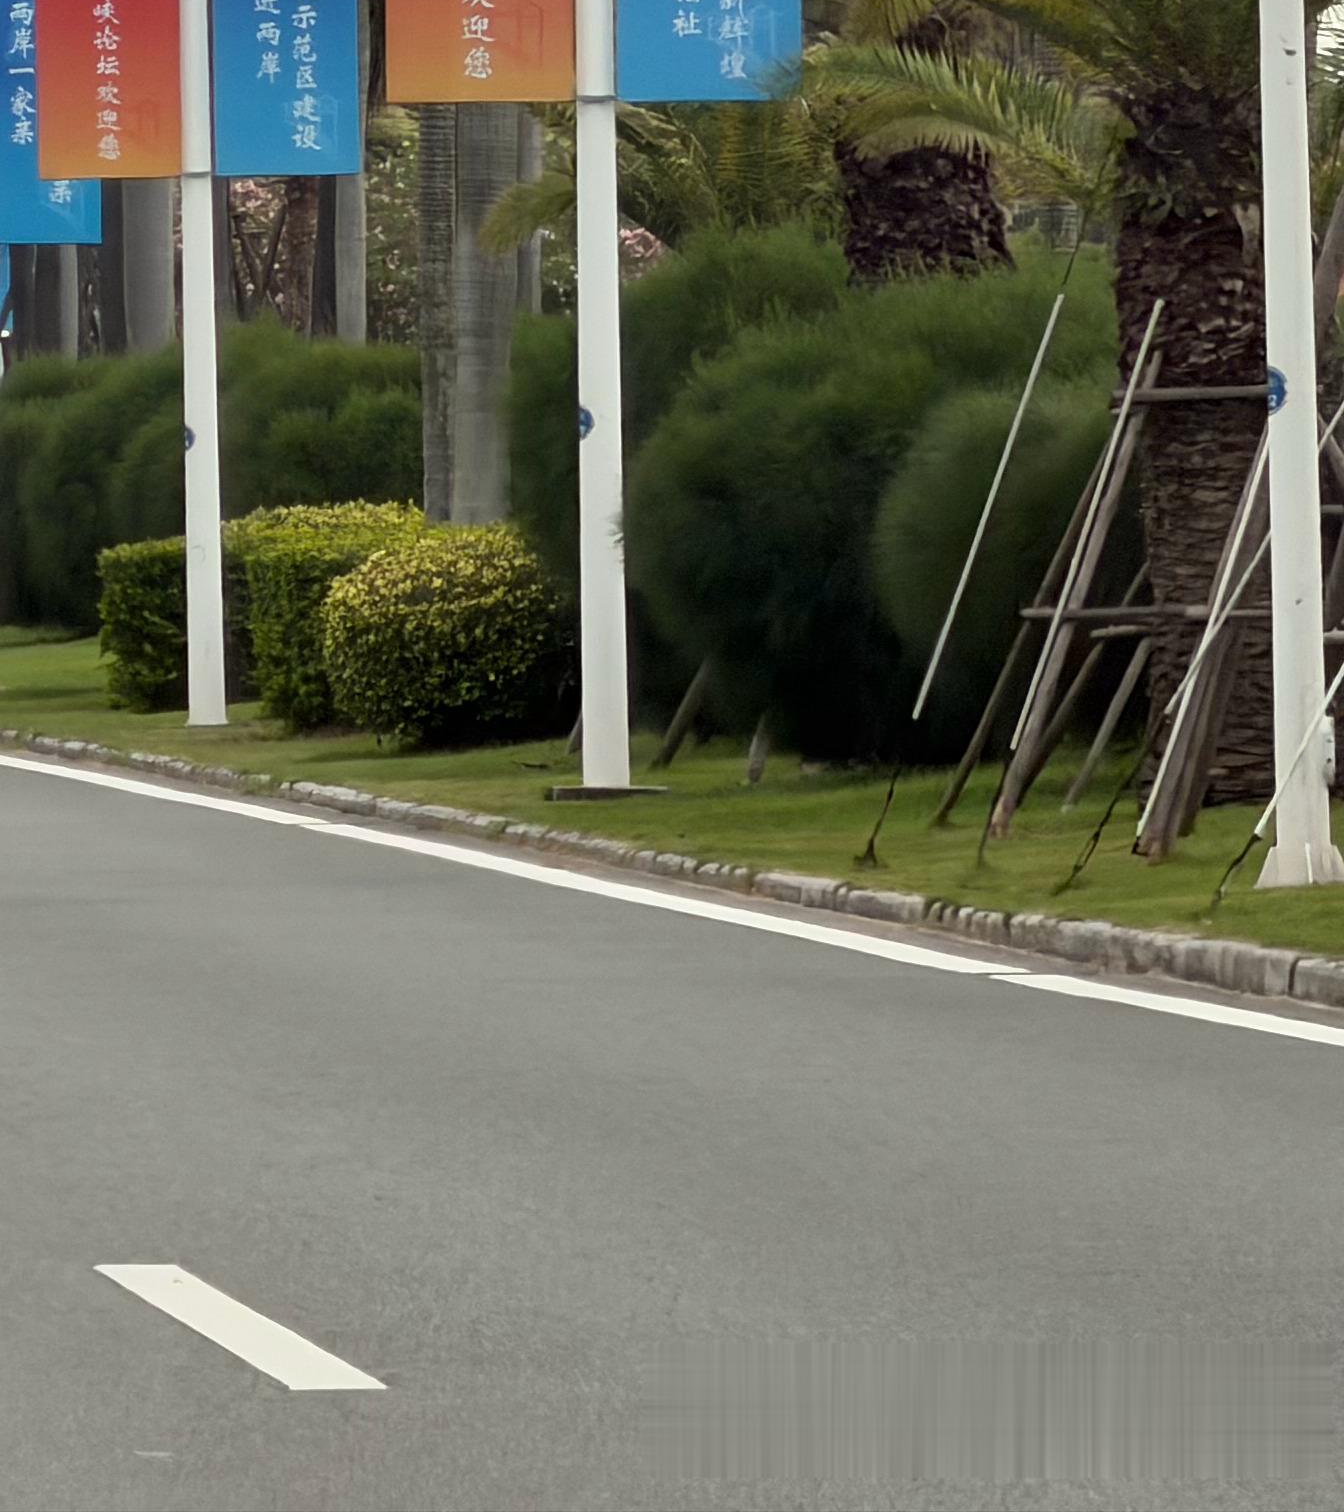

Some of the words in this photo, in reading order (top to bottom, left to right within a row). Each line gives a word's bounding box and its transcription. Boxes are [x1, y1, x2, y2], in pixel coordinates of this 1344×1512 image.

[8, 1, 35, 144] 两岸一家亲
